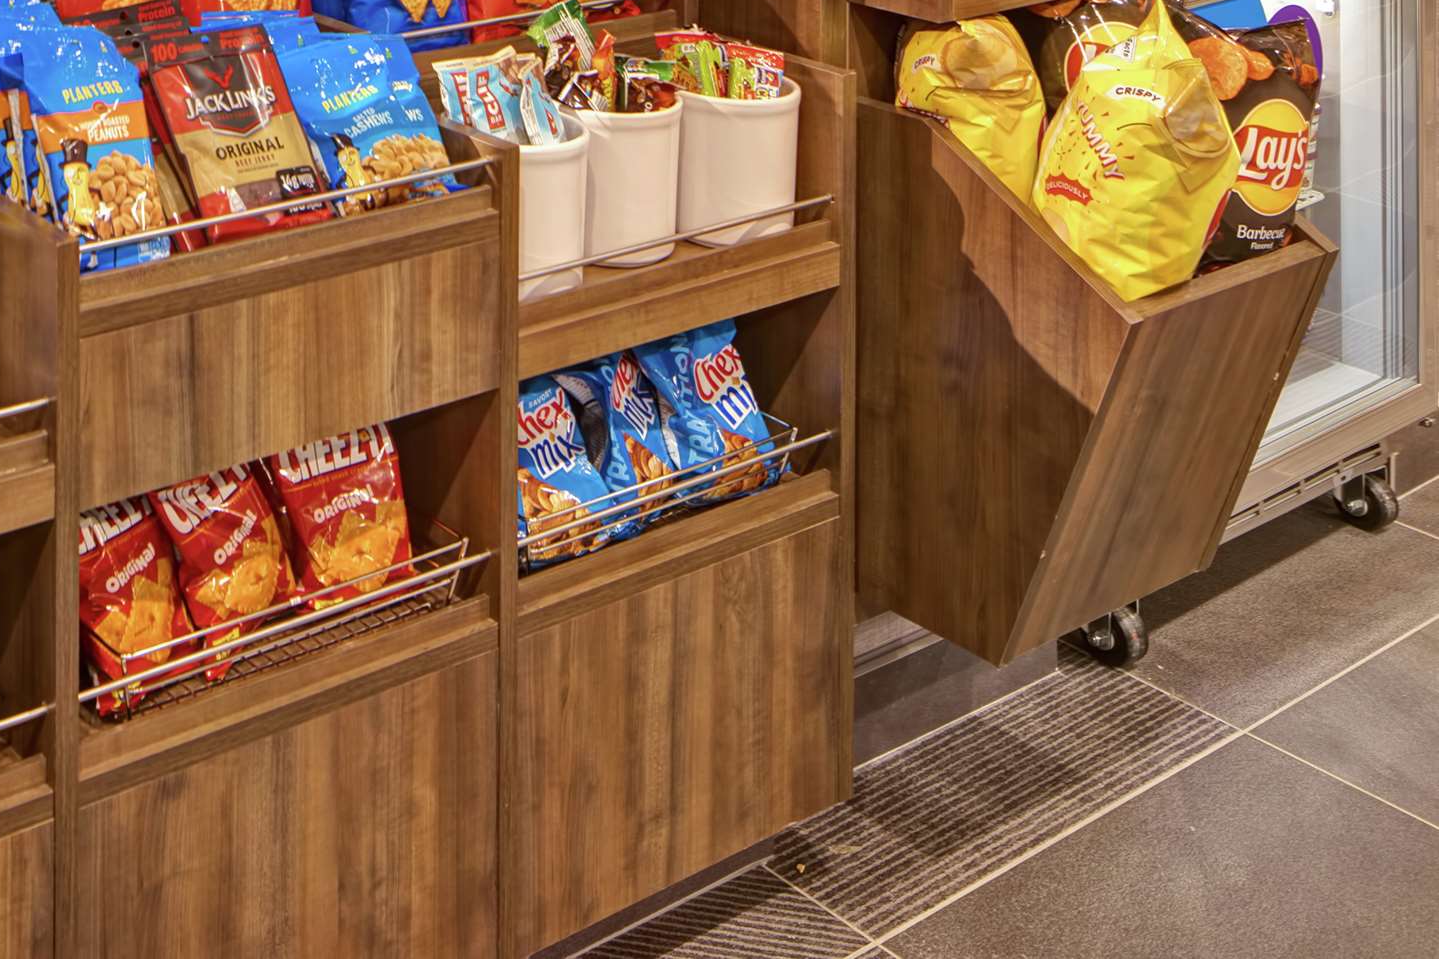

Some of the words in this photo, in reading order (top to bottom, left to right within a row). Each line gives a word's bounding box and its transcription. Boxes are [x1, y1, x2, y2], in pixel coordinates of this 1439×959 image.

[150, 42, 178, 62] 100
[61, 79, 124, 105] PLANTERS
[1115, 86, 1161, 103] CRISPY
[184, 93, 232, 120] JACK
[87, 124, 130, 143] PEANUTS
[343, 110, 394, 139] CASHEWS
[215, 136, 285, 161] ORIGINAL
[1238, 126, 1307, 191] Lay's
[1044, 177, 1089, 200] DELICIOUSLY
[1236, 224, 1286, 242] Barbecue
[693, 343, 742, 405] Chex
[528, 388, 552, 409] SAVORY
